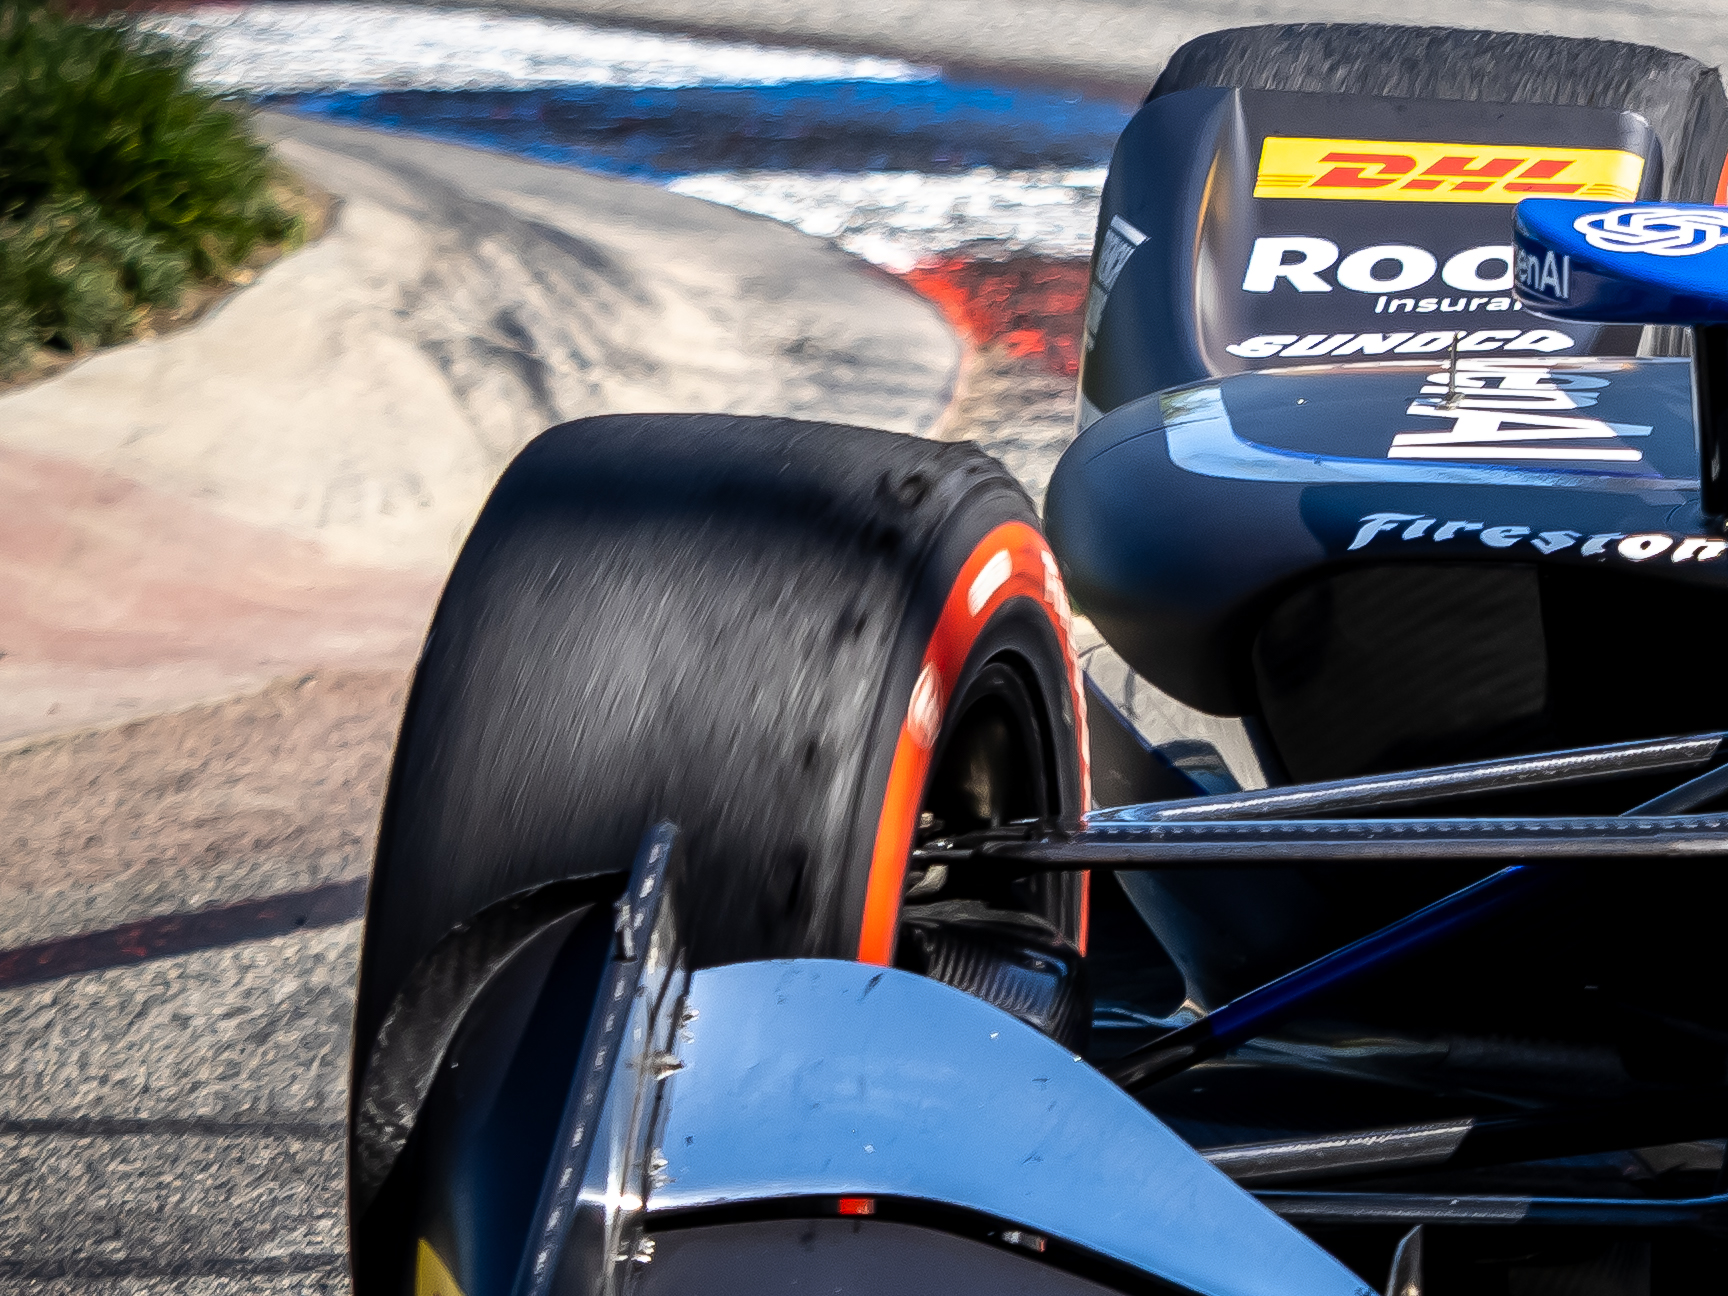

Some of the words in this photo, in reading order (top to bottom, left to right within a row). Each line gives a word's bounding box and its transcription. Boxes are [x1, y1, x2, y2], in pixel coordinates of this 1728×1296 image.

[1310, 152, 1584, 194] DHL
[1242, 236, 1513, 294] Roo
[1374, 296, 1523, 314] Insura
[1225, 330, 1575, 358] SUNOCO
